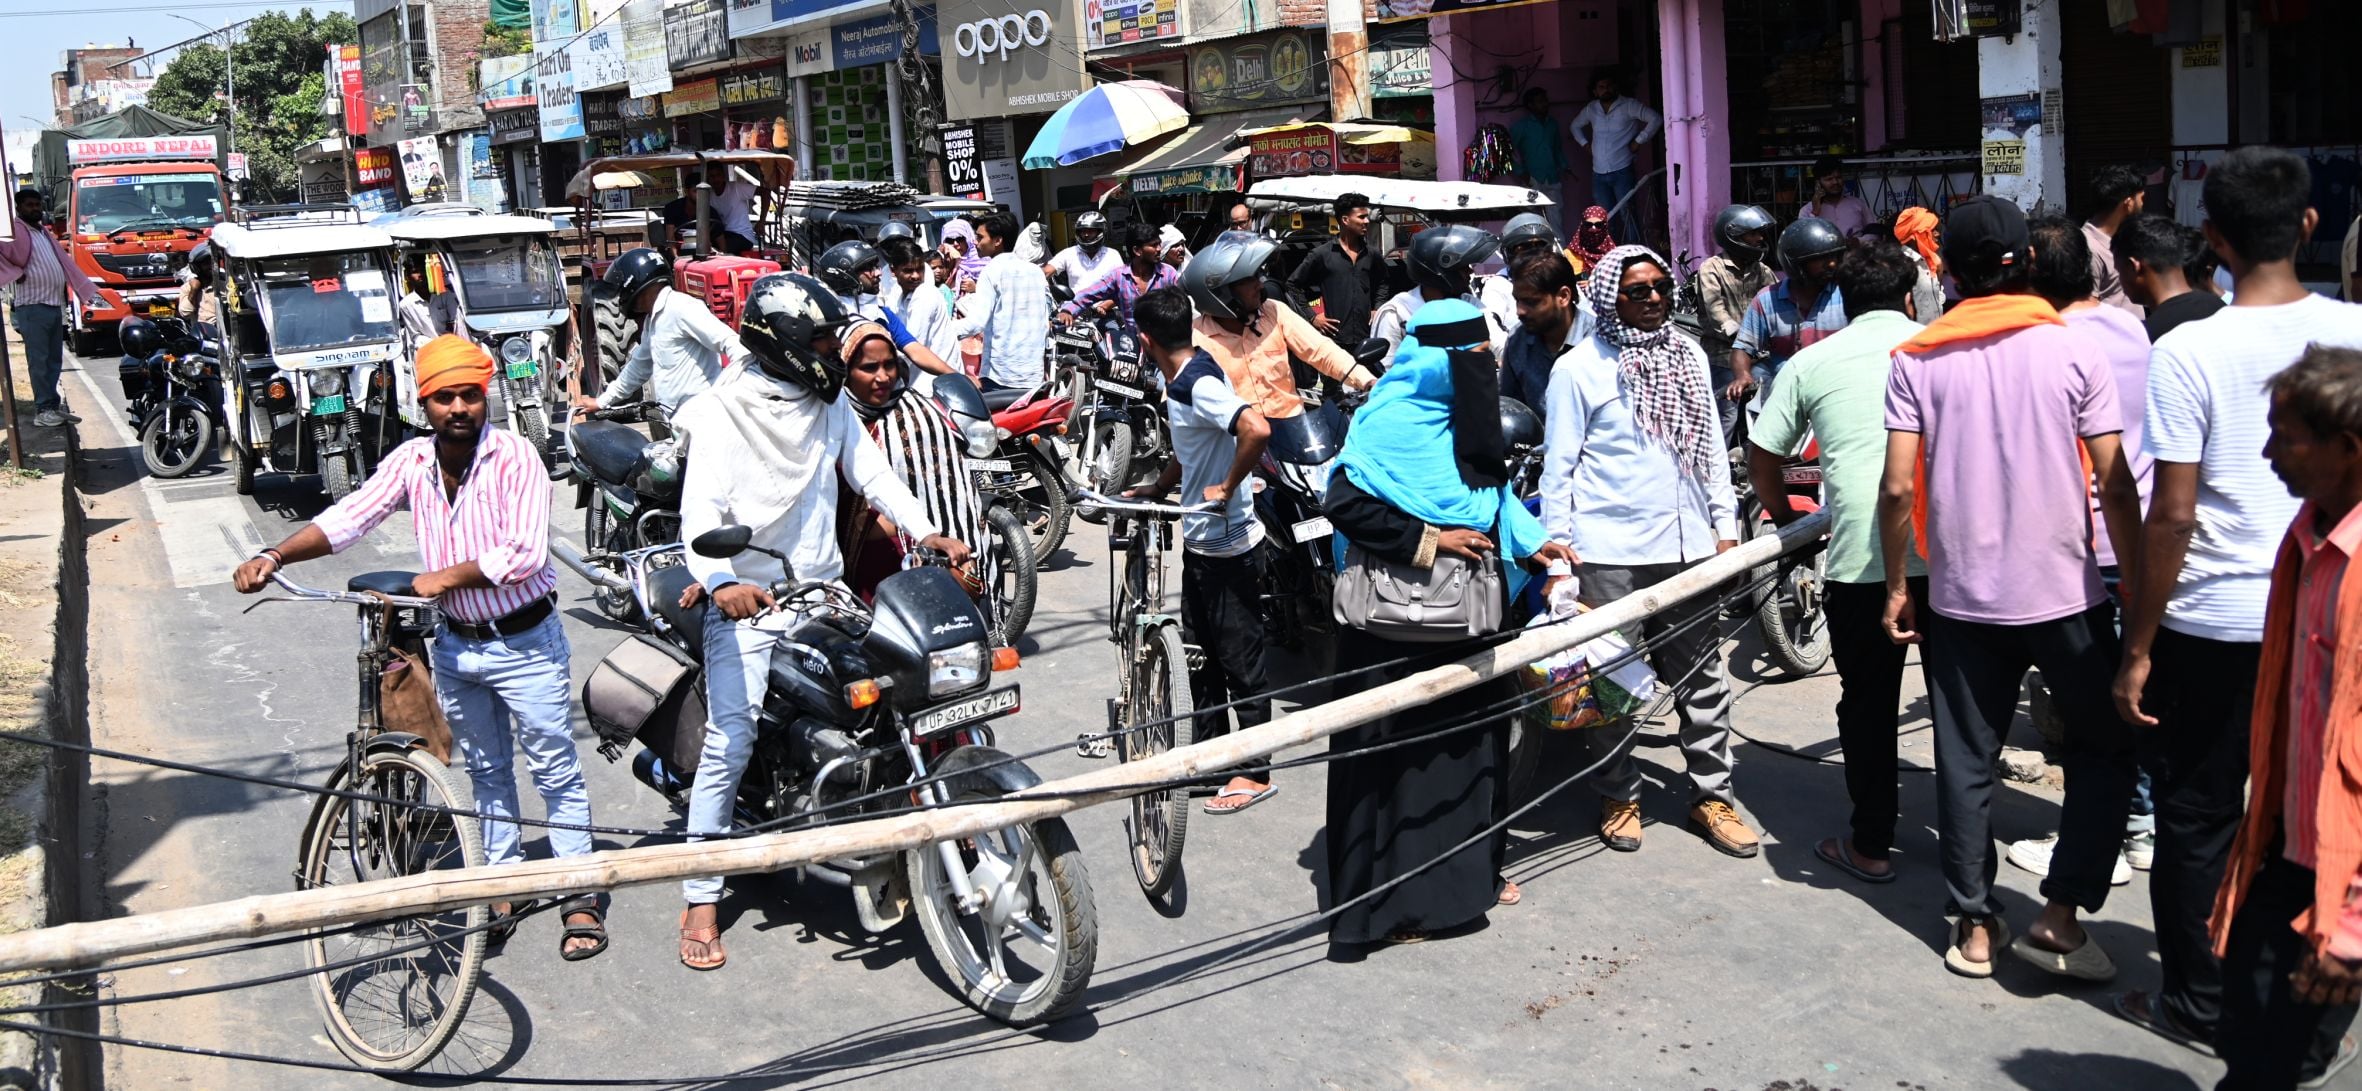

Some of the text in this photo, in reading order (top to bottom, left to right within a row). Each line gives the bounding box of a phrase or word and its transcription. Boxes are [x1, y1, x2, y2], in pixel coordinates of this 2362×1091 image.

[1141, 16, 1154, 25] POCO
[841, 20, 903, 43] Neeraj Automobiles
[955, 9, 1052, 64] oppo
[342, 47, 360, 59] HIND
[795, 43, 821, 64] Mobil
[342, 59, 361, 72] BAND
[537, 49, 556, 77] Hari
[1236, 55, 1264, 83] Delhi
[541, 80, 576, 109] Traders
[1009, 89, 1079, 106] ABHISHEK MOBILE SHOP
[944, 129, 973, 141] ABHISHEK
[77, 139, 212, 156] INDORE NEPAL
[945, 138, 974, 150] MOBILE
[1985, 142, 2021, 156] लोन
[360, 154, 390, 168] HIND
[946, 147, 975, 160] SHOP
[360, 167, 392, 181] BAND
[948, 159, 978, 181] 0%
[952, 182, 979, 193] Finance
[1133, 177, 1159, 192] DELHI
[1160, 174, 1177, 192] Juice
[1181, 169, 1202, 186] Shake
[306, 185, 321, 194] THE
[784, 350, 806, 372] CLARO
[803, 658, 824, 674] Hero
[929, 713, 943, 729] UP
